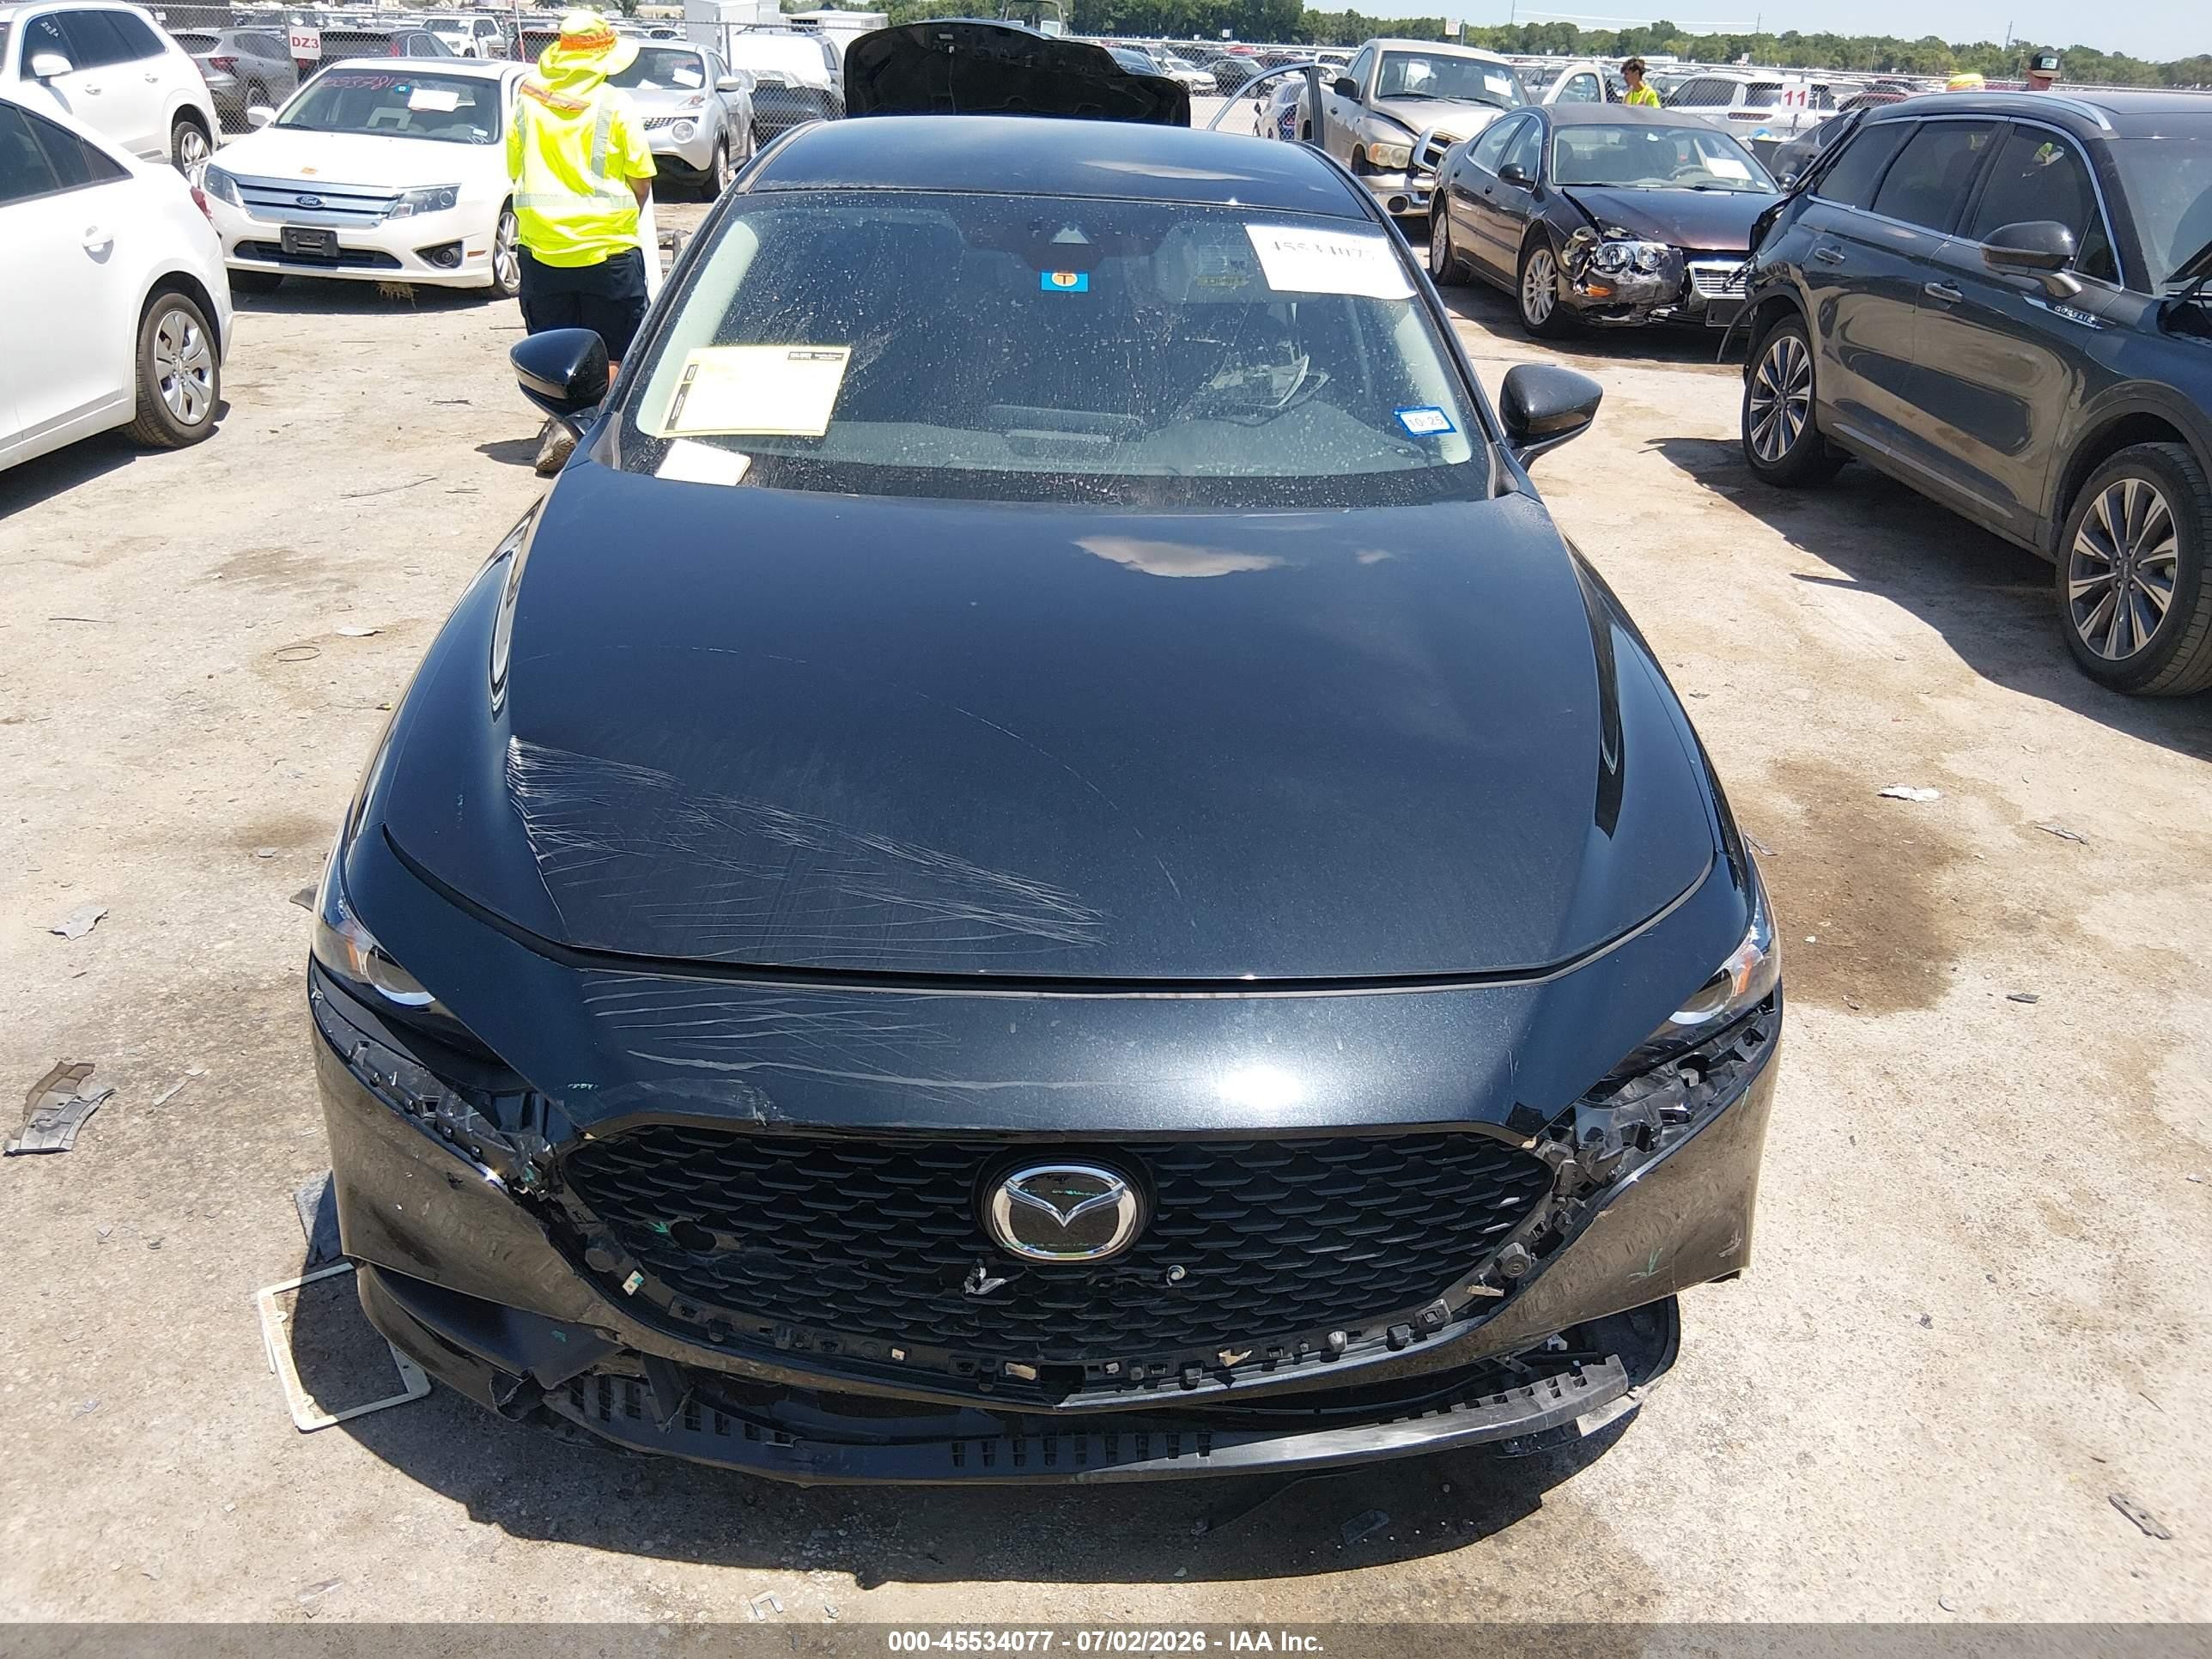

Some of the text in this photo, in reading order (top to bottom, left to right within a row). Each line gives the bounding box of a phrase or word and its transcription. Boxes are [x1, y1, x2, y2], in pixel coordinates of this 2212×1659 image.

[292, 37, 319, 49] DZ3
[1784, 90, 1806, 106] 11
[301, 195, 319, 205] Ford
[2055, 305, 2095, 324] CORSAIR
